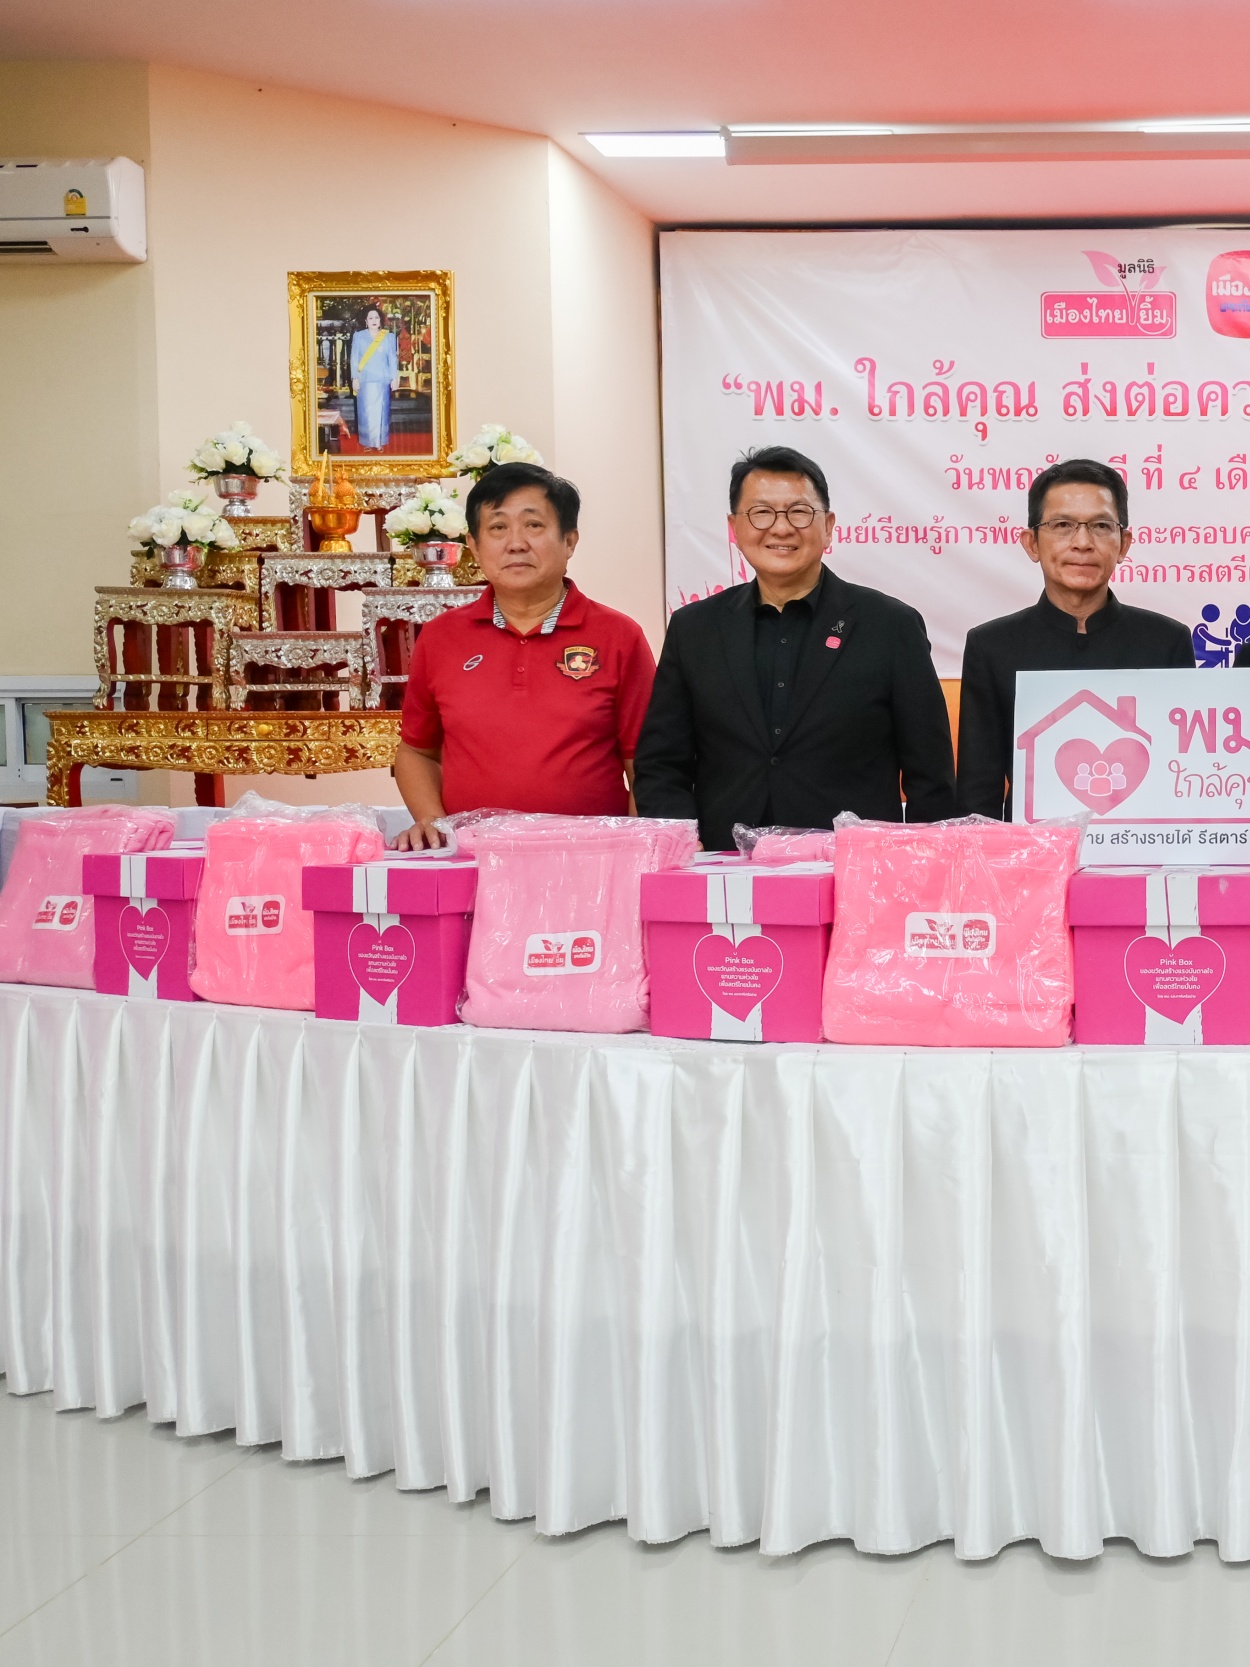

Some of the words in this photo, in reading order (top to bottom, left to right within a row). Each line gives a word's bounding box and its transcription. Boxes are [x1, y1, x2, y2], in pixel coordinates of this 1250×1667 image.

[1117, 259, 1155, 278] มูลนิธิ
[1046, 297, 1127, 324] เมืองไทย
[1139, 296, 1167, 324] ยิ้ม
[854, 357, 1039, 441] ใกล้คุณ
[1142, 444, 1163, 490] ที่
[1178, 464, 1202, 490] ๔
[1110, 829, 1194, 844] สร้างรายได้
